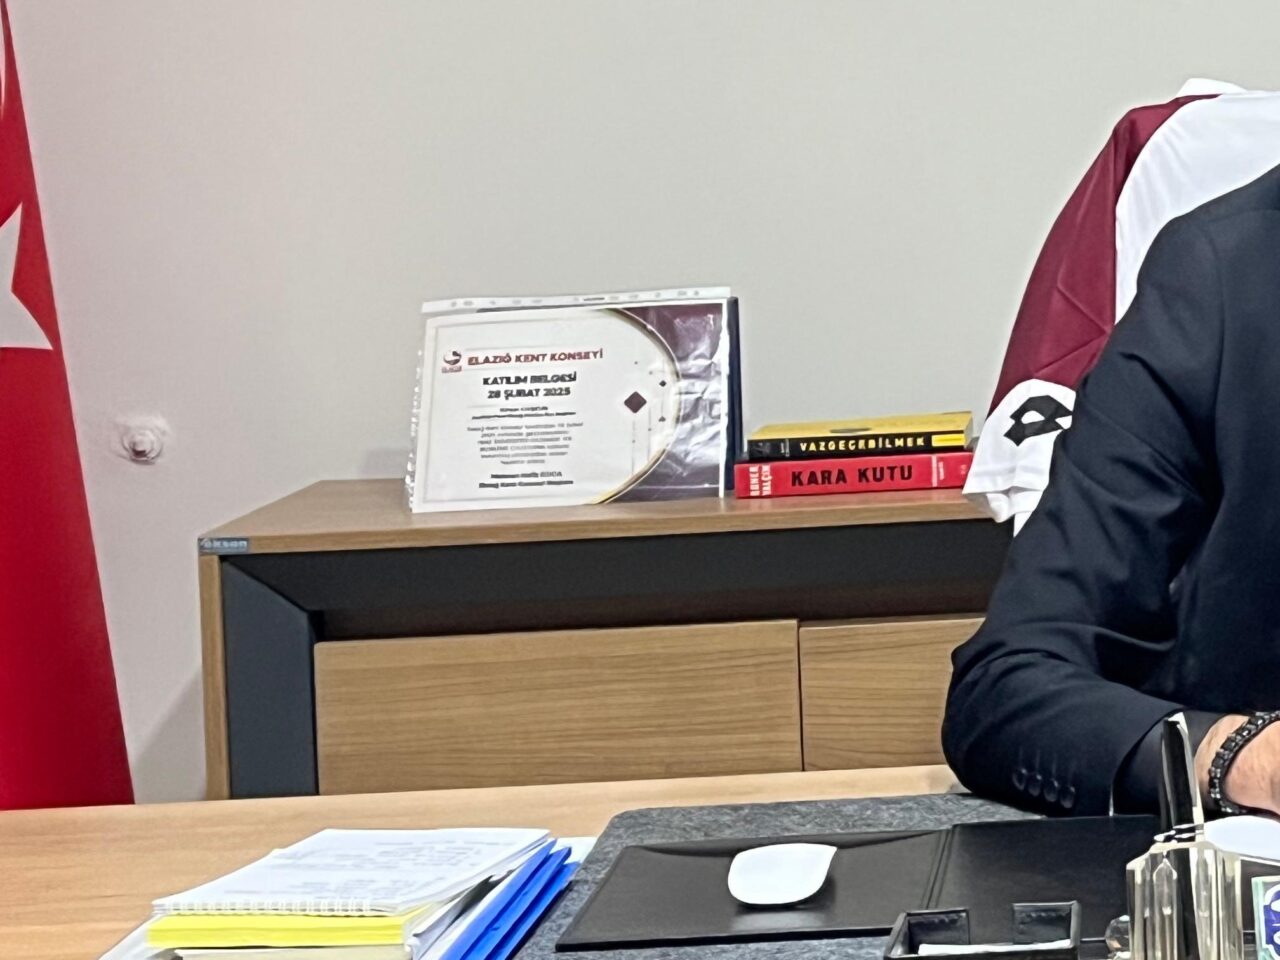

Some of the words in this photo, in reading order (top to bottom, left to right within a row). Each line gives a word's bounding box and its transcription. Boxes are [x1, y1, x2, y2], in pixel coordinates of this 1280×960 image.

[515, 353, 547, 363] KENT
[550, 348, 603, 361] KONSEYİ
[483, 375, 528, 385] KATILIM
[530, 371, 577, 384] BELGESİ
[487, 390, 501, 399] 28
[504, 388, 541, 401] ŞUBAT
[543, 386, 571, 397] 2025
[791, 468, 848, 487] KARA
[857, 464, 913, 483] KUTU
